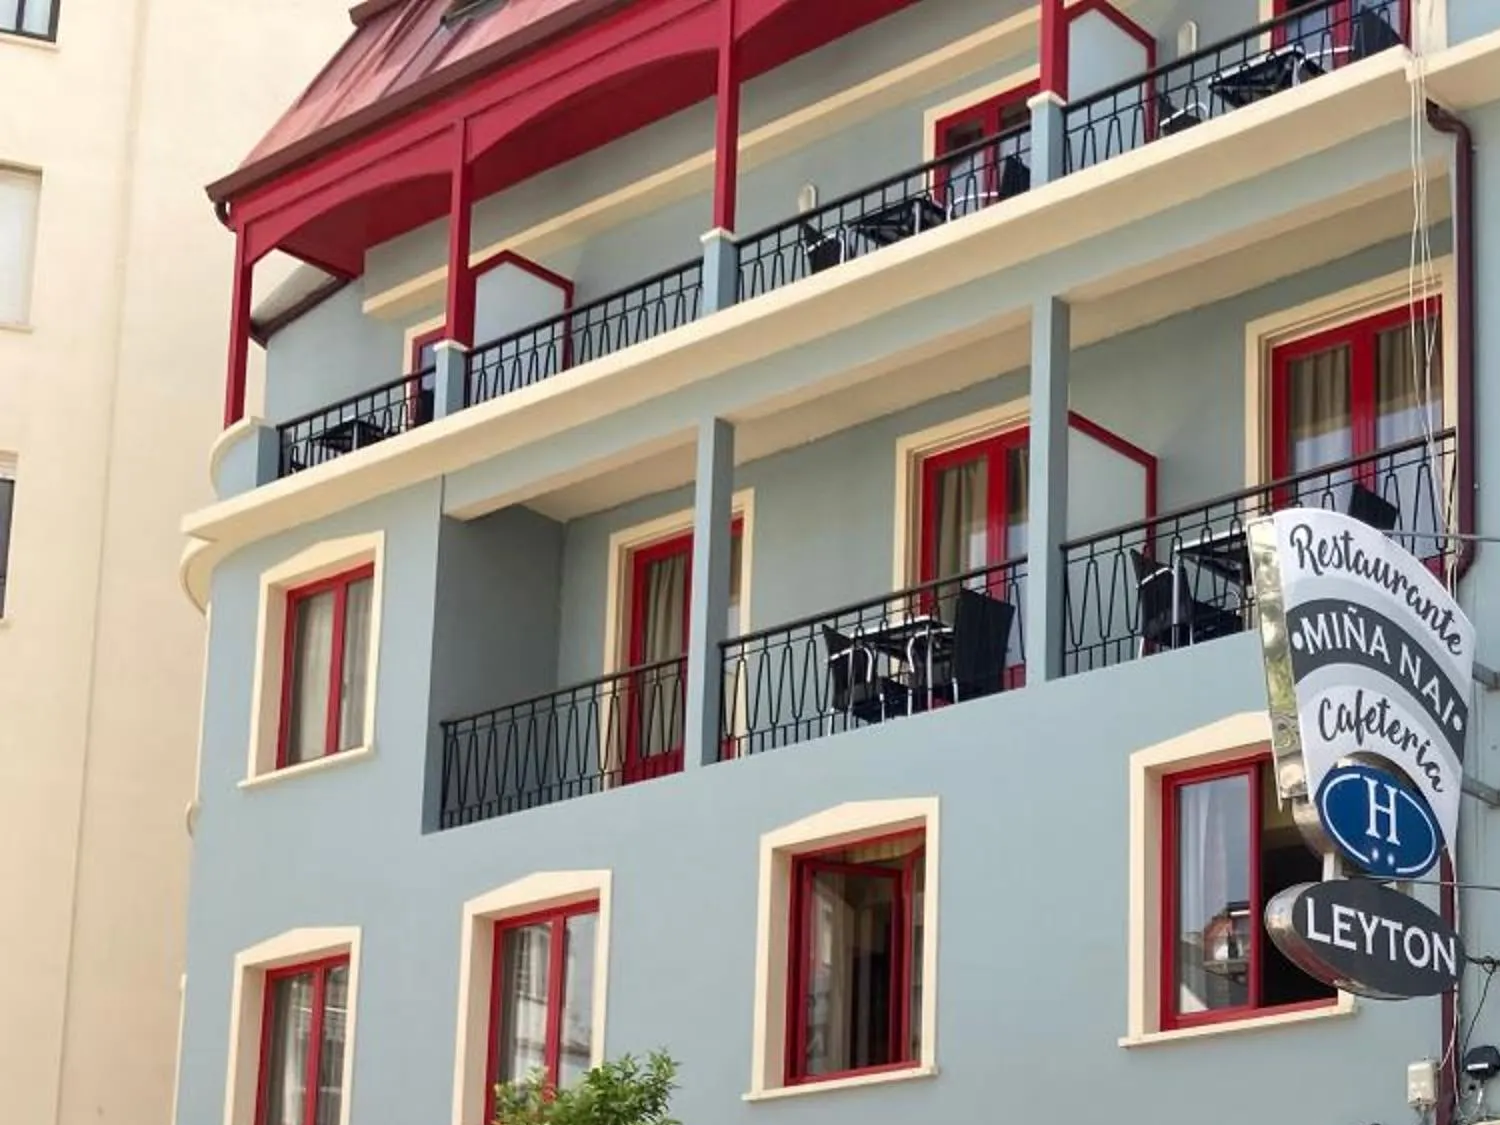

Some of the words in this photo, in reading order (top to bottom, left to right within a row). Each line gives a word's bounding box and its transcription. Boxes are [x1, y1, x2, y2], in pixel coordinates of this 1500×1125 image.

[1289, 522, 1463, 656] Restaurante
[1299, 607, 1391, 666] MIÑA
[1400, 643, 1454, 730] NAI
[1317, 689, 1445, 794] Cafeteria
[1362, 776, 1400, 846] H
[1305, 897, 1458, 977] LEYTON
